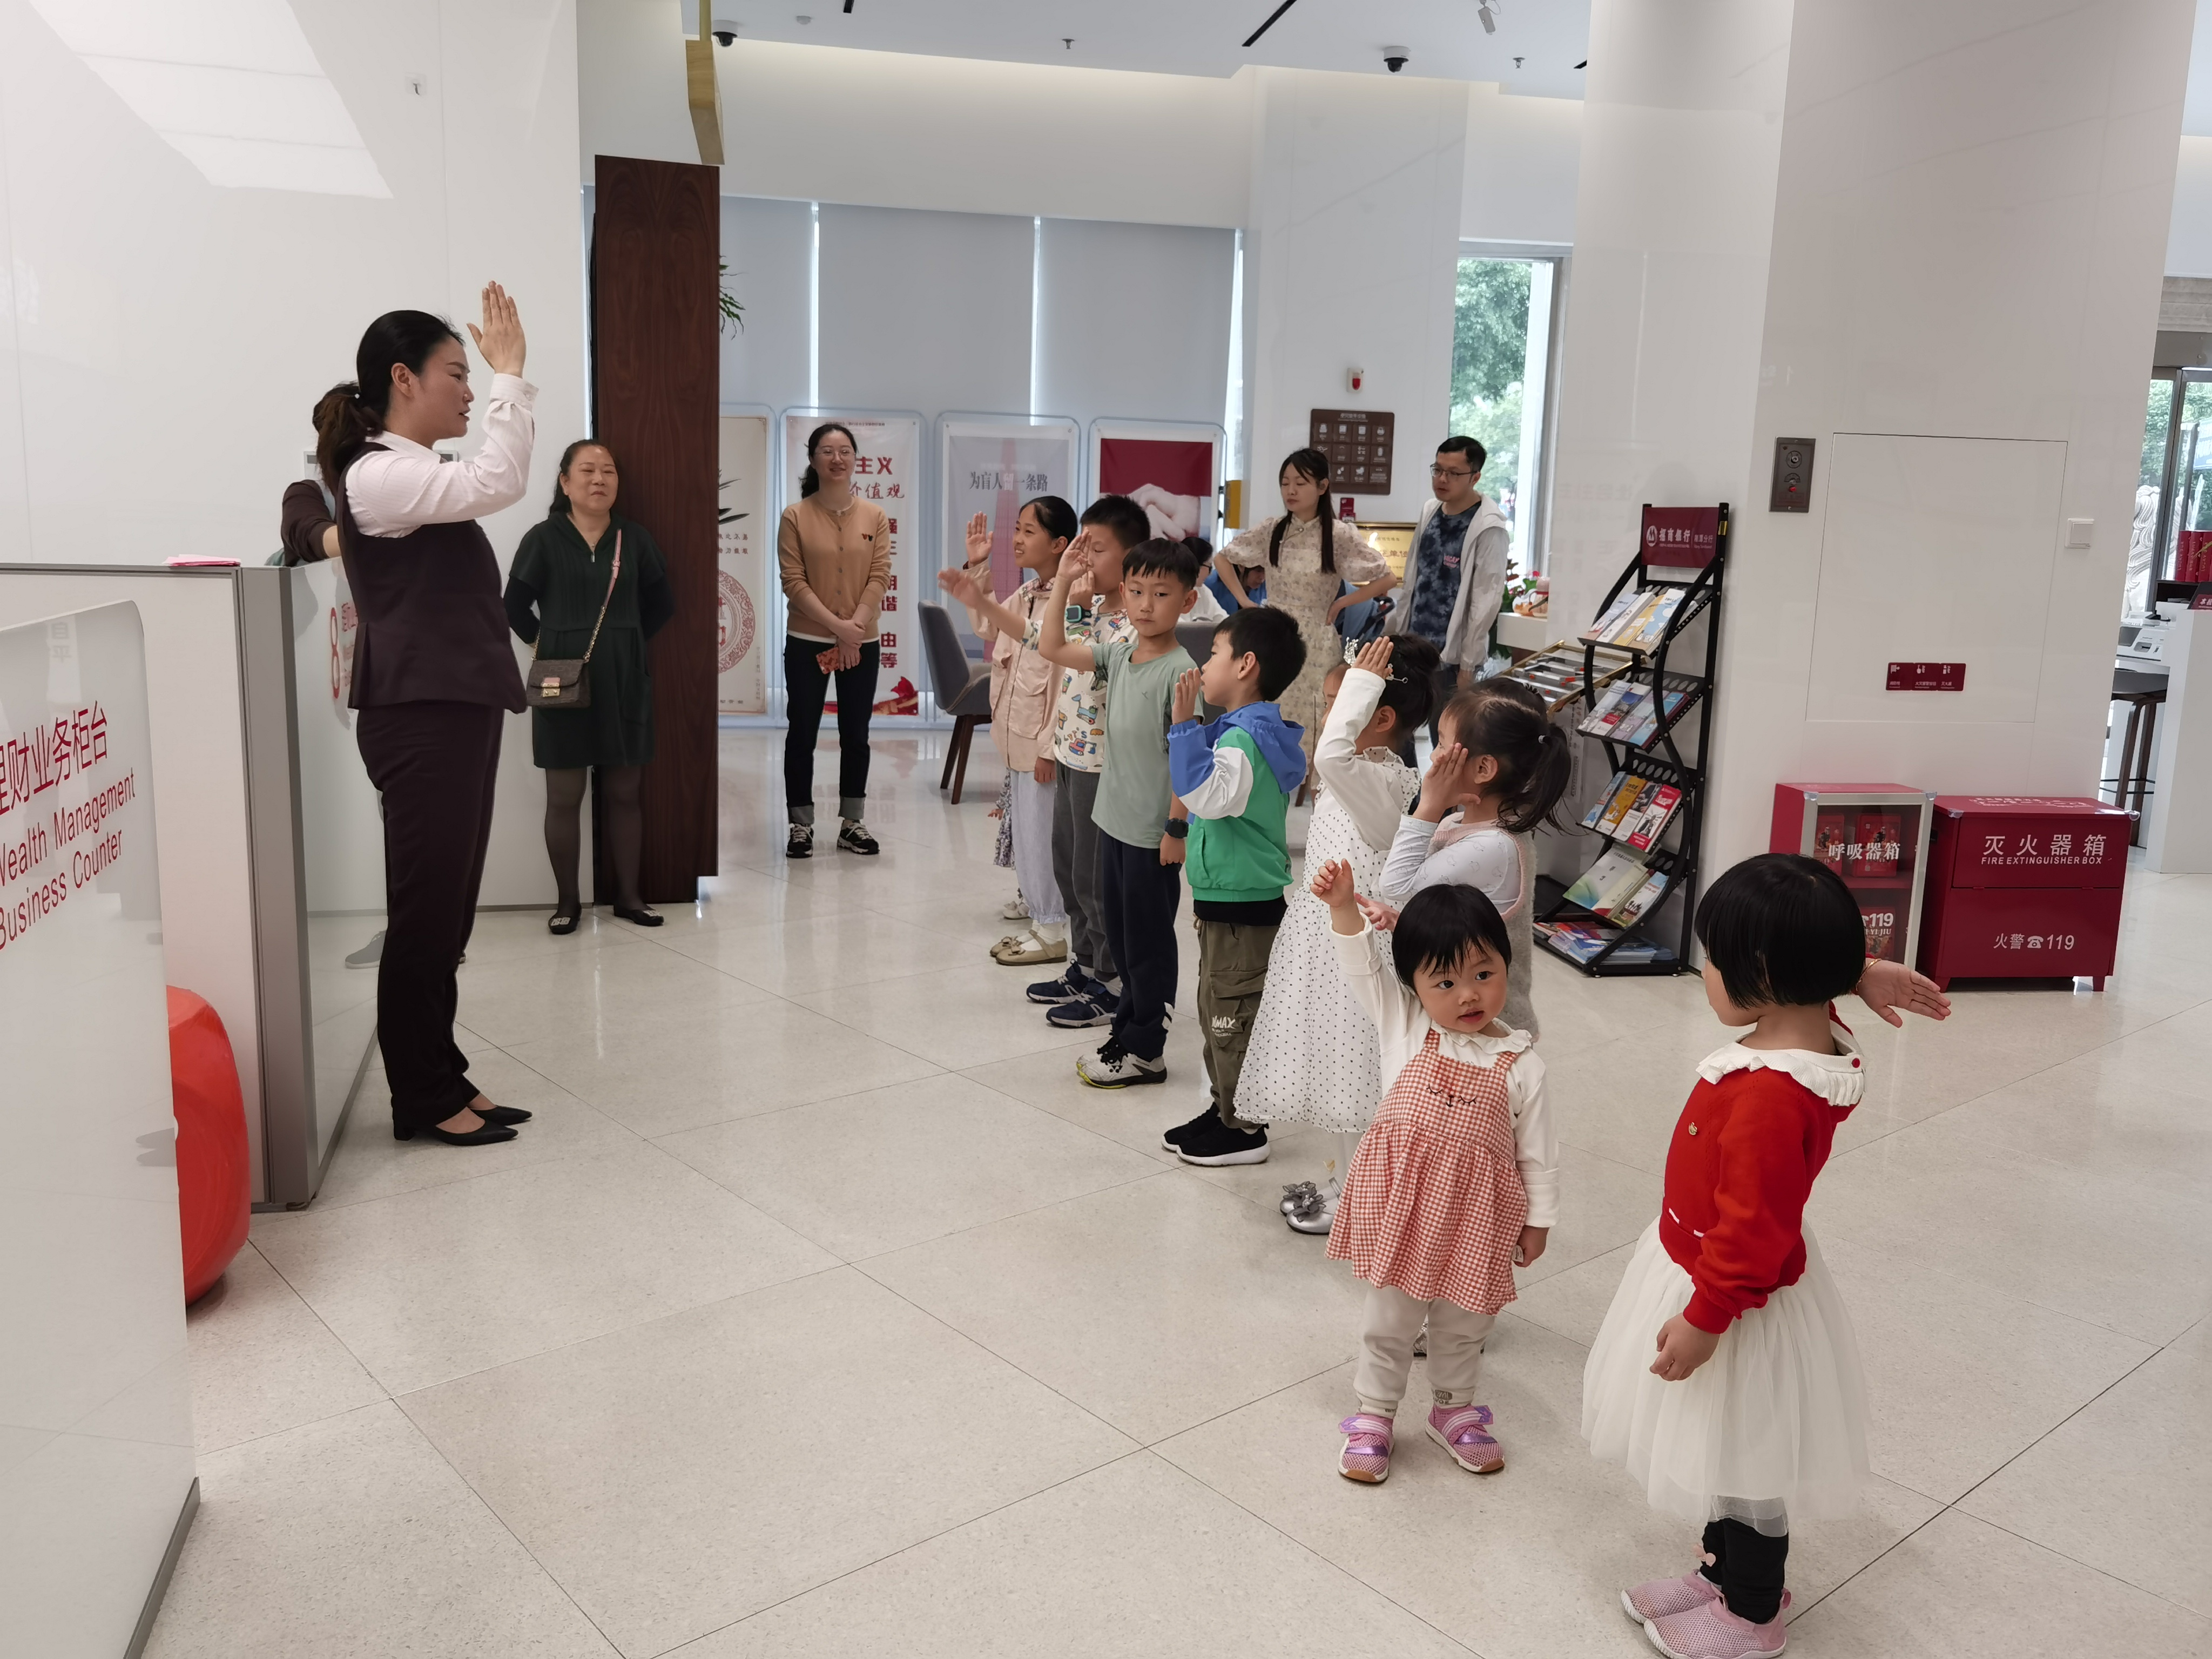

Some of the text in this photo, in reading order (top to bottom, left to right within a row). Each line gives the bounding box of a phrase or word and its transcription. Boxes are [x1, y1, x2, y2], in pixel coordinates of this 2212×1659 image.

[855, 456, 893, 475] 主义
[881, 632, 897, 648] 由
[0, 767, 136, 887] ealth Management
[1828, 842, 1900, 861] 呼吸器箱
[1983, 834, 2106, 856] 灭火器箱
[1981, 857, 2004, 865] FIRE
[2006, 857, 2080, 865] EXTINGUISHER
[0, 829, 123, 950] Business Counter
[1869, 913, 1894, 927] 119
[1879, 928, 1892, 936] JIU
[1993, 933, 2075, 950] 火警 119
